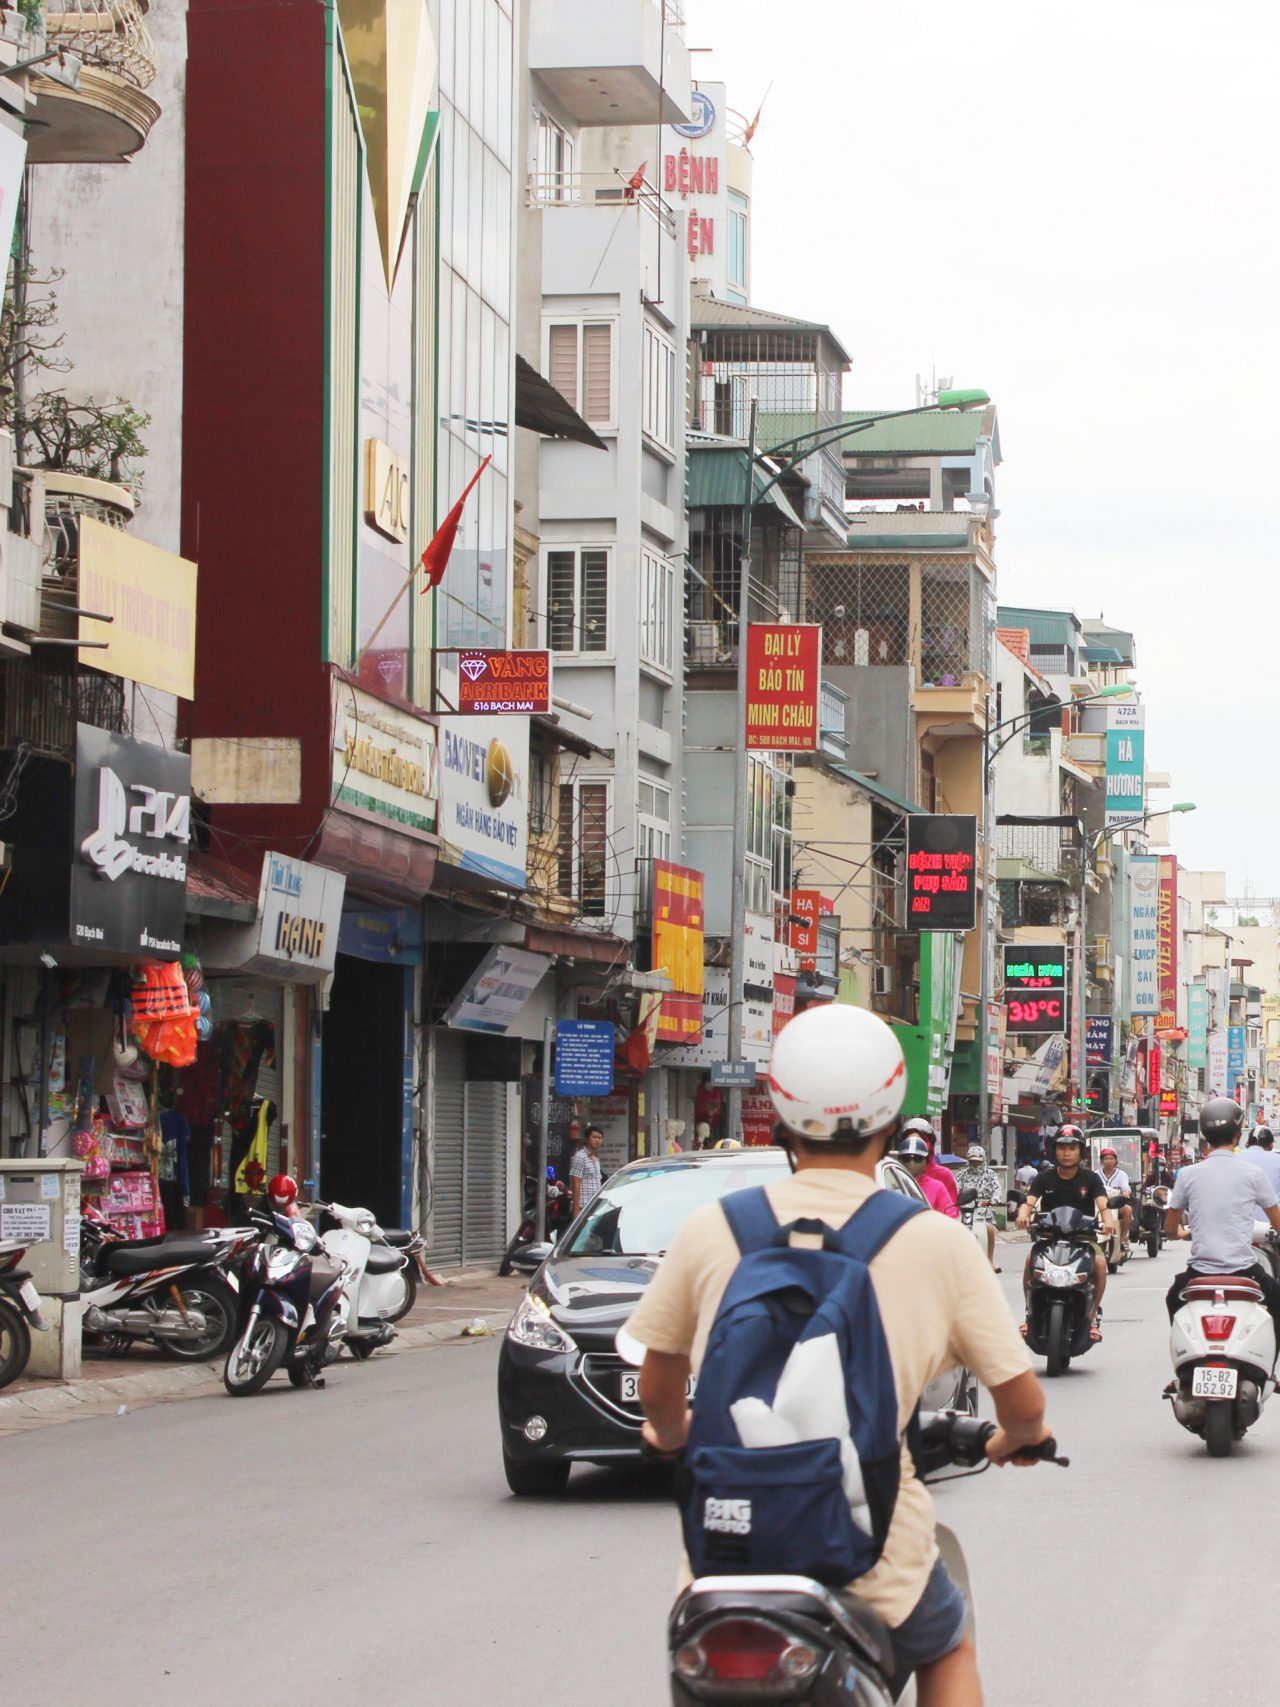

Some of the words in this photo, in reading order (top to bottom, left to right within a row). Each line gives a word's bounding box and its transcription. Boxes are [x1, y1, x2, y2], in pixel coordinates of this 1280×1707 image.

[664, 147, 719, 200] BỆNH
[765, 633, 785, 660] ĐẠI
[787, 629, 801, 656] LÝ
[759, 661, 782, 691] BẢO
[786, 665, 805, 691] TÍN
[460, 682, 548, 700] AGRIBANK
[474, 701, 489, 711] 516
[491, 701, 515, 712] BẠCH
[517, 701, 534, 710] MAI
[748, 704, 779, 726] MINH
[782, 701, 813, 727] CHÂU
[1117, 708, 1137, 716] 472A
[1118, 736, 1133, 761] HÀ
[456, 802, 474, 829] NGÂN
[475, 812, 492, 839] HÀNG
[909, 851, 942, 870] BỆNH
[944, 852, 972, 872] VIỆN
[914, 875, 939, 893] PHỤ
[941, 870, 968, 891] SẢN
[276, 911, 327, 961] HẠNH
[823, 1103, 860, 1116] YAMAHA
[1202, 1370, 1231, 1383] 15-B2
[1195, 1383, 1234, 1396] 052.92
[705, 1497, 751, 1521] BIG
